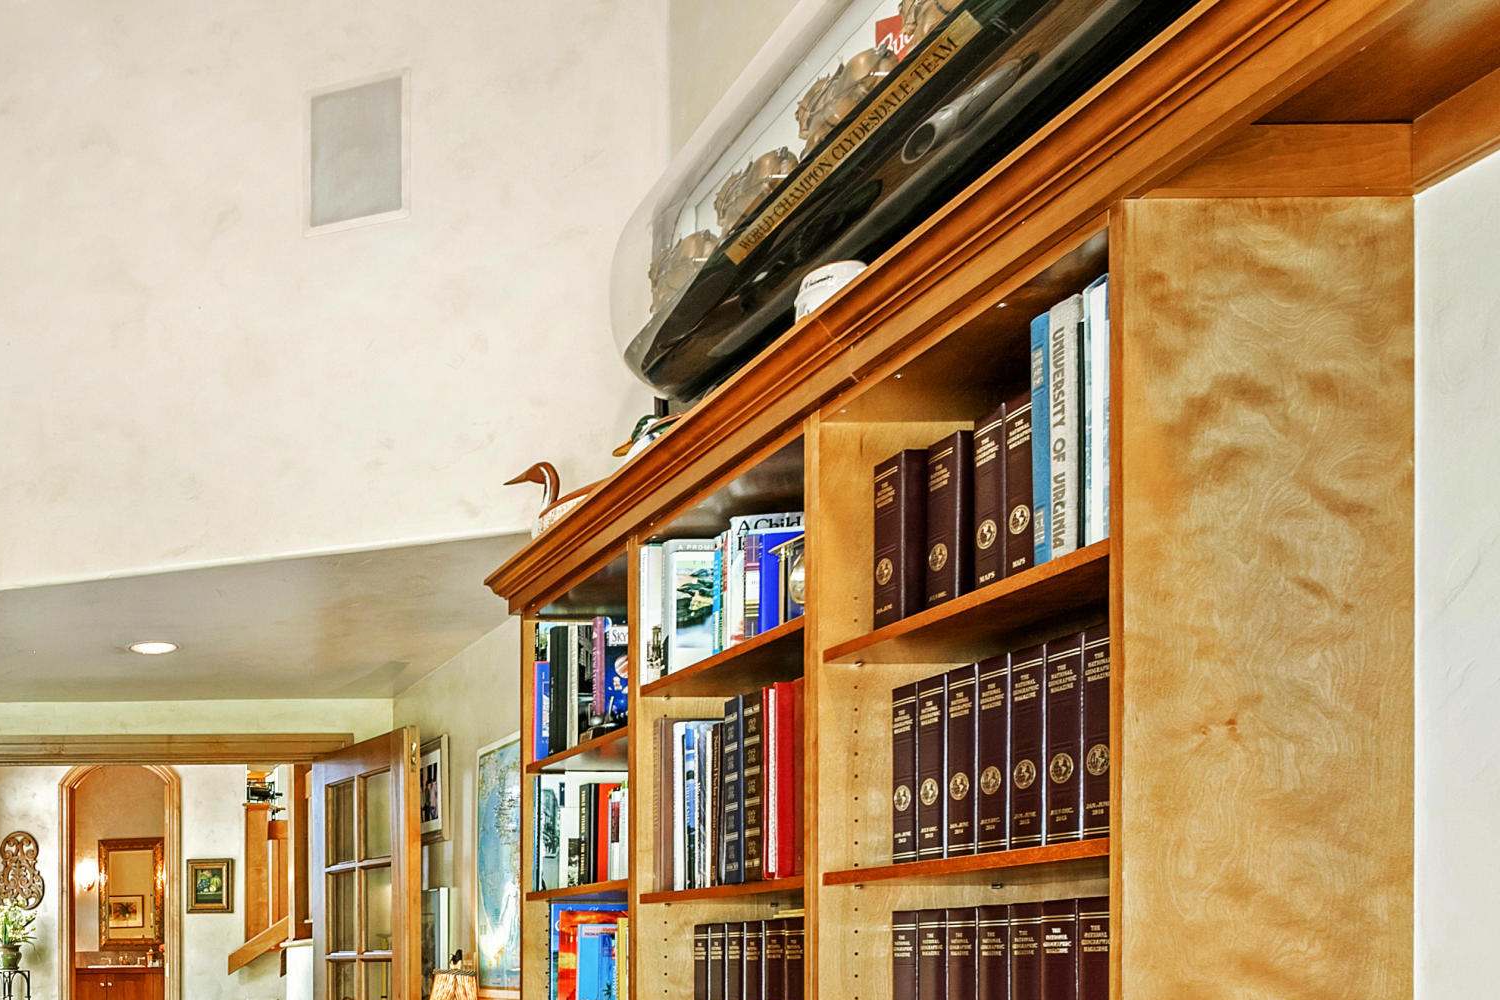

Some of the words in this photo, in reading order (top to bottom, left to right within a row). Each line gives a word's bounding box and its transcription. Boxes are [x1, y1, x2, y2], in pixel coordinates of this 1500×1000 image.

[738, 216, 775, 251] WORLD
[773, 157, 834, 220] CHAMPION
[832, 79, 914, 162] CLYDESDALE
[910, 36, 959, 82] TEAM
[1052, 325, 1066, 429] UNIVERSITY
[1052, 437, 1066, 462] OF
[737, 520, 750, 535] A
[754, 516, 801, 530] Child
[1051, 472, 1066, 550] VIRGINIA
[979, 571, 996, 584] MAPS
